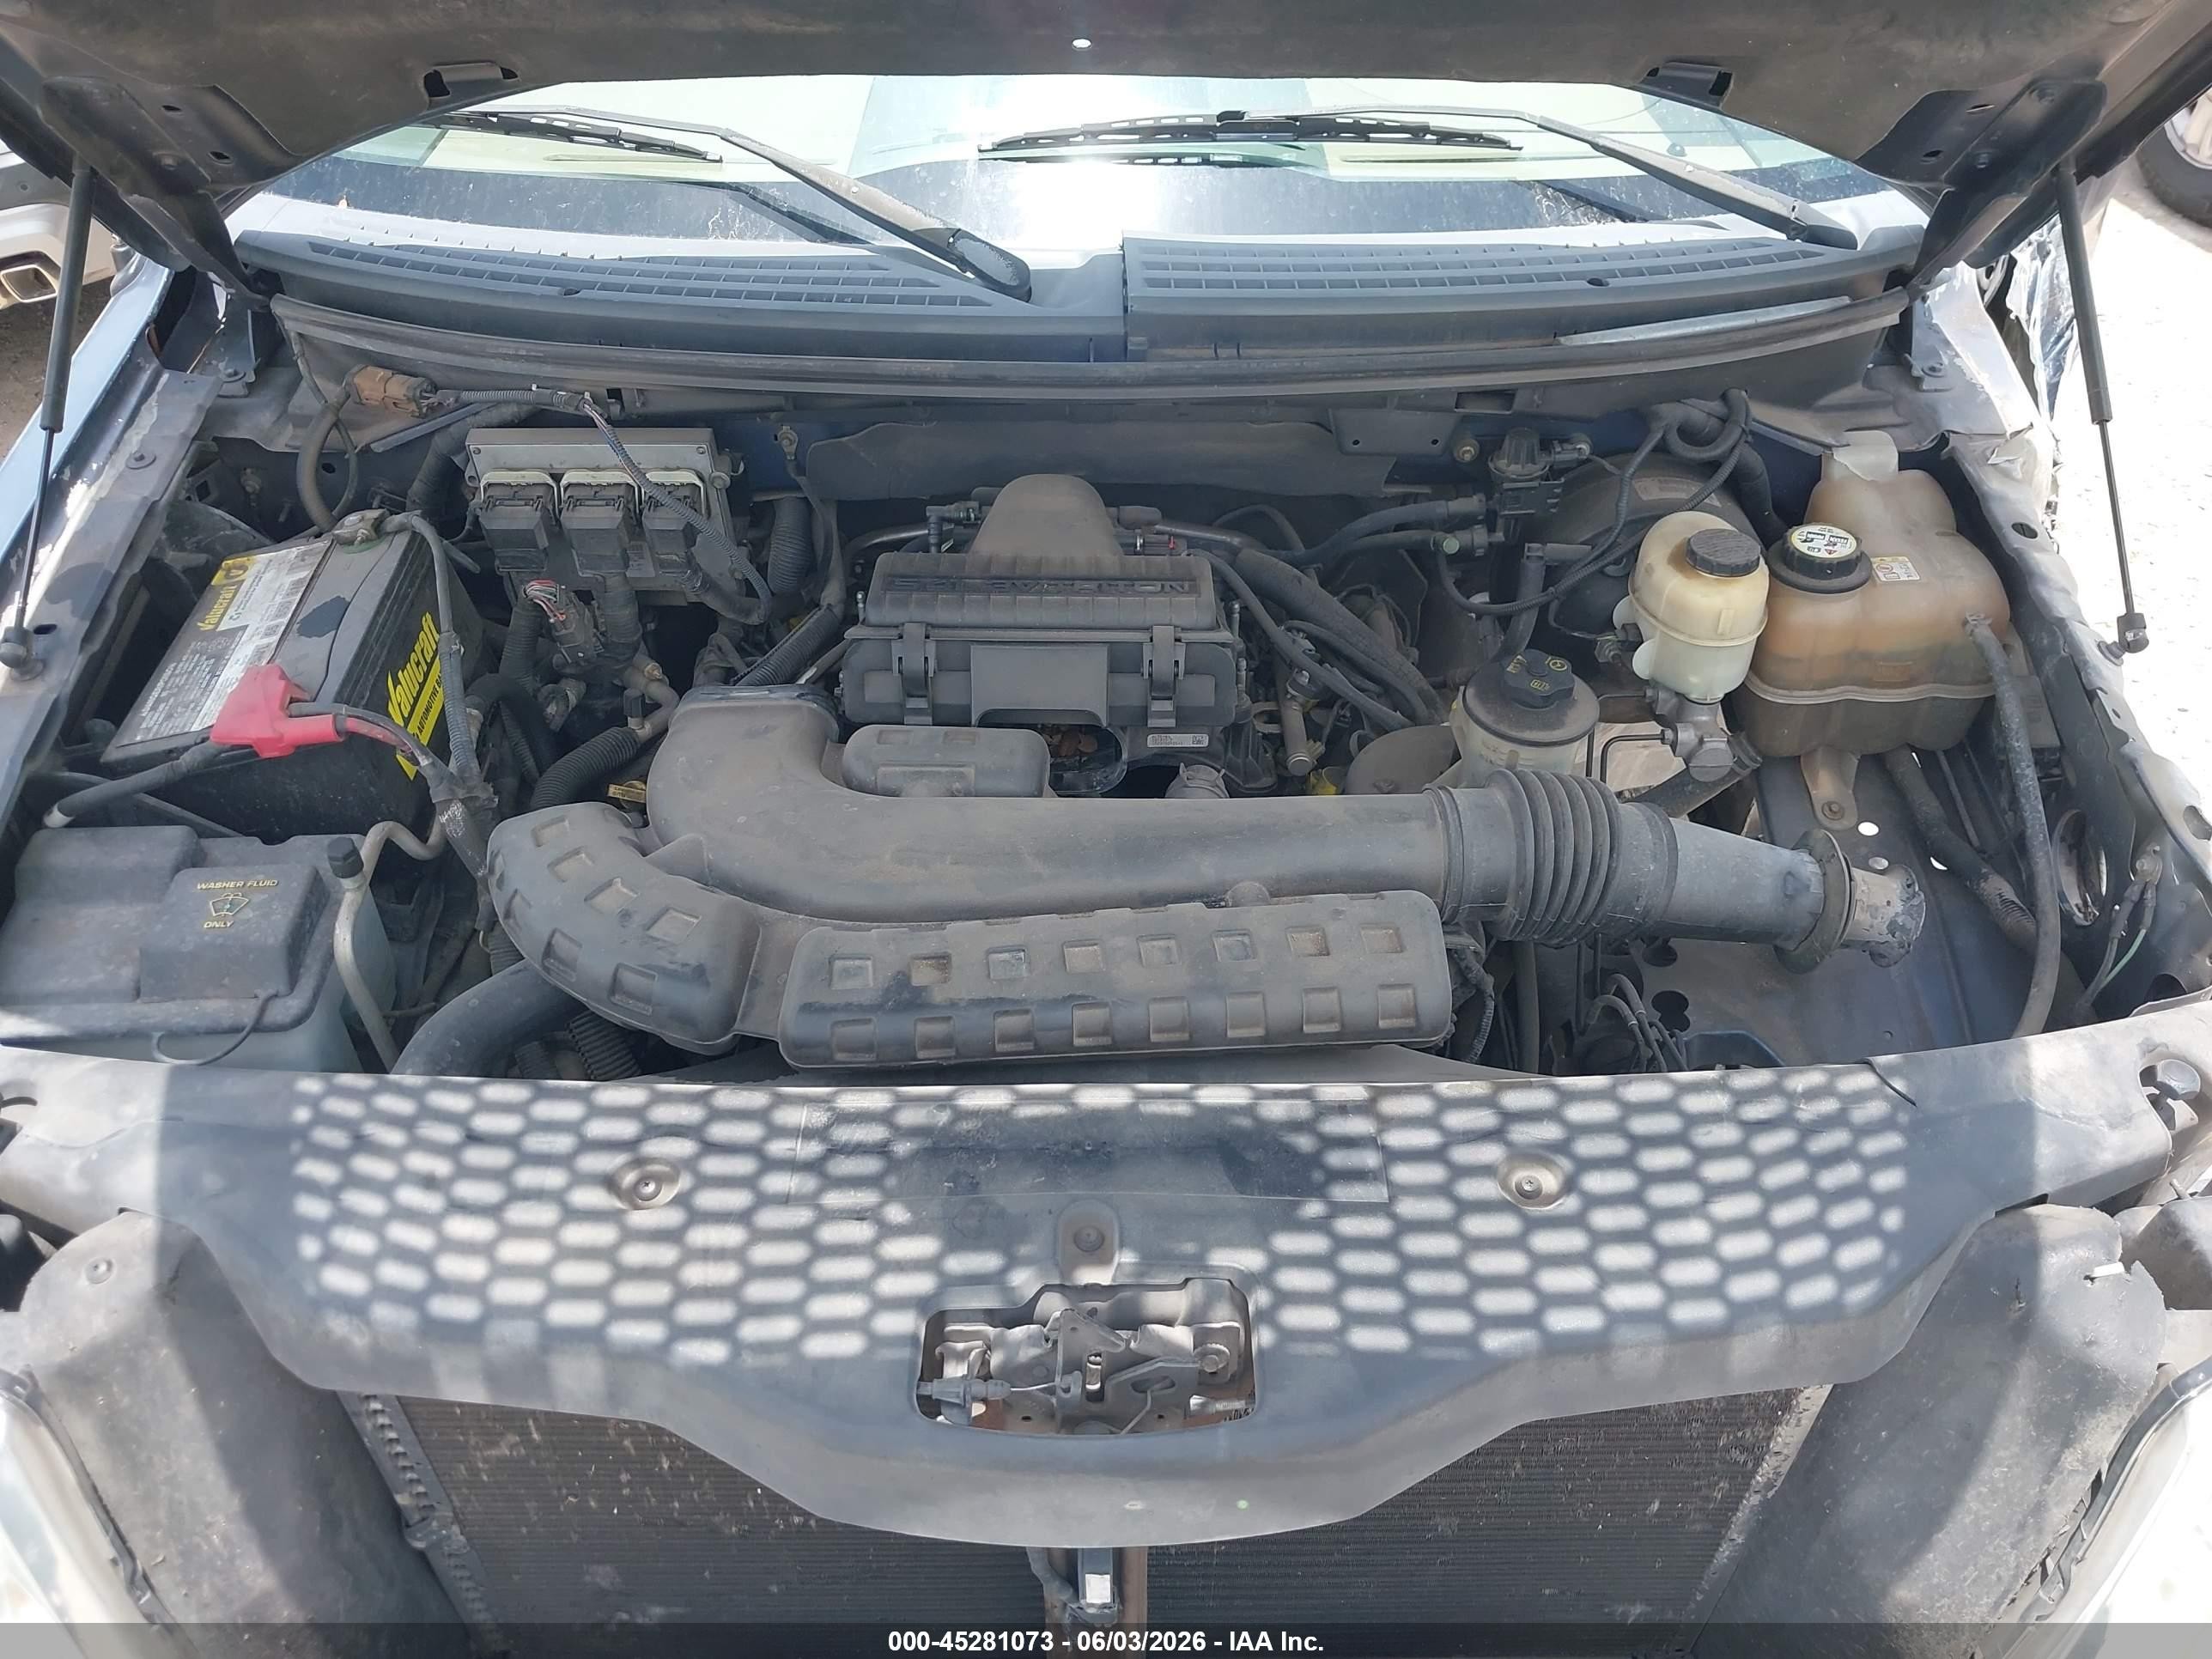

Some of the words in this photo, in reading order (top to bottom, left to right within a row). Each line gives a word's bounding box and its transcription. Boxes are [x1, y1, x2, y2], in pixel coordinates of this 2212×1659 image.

[197, 584, 238, 631] Valucraft
[388, 611, 440, 726] Valucraft
[417, 684, 439, 735] AUTOMOTIVE
[197, 881, 245, 890] WASHER
[246, 879, 279, 888] FLUID
